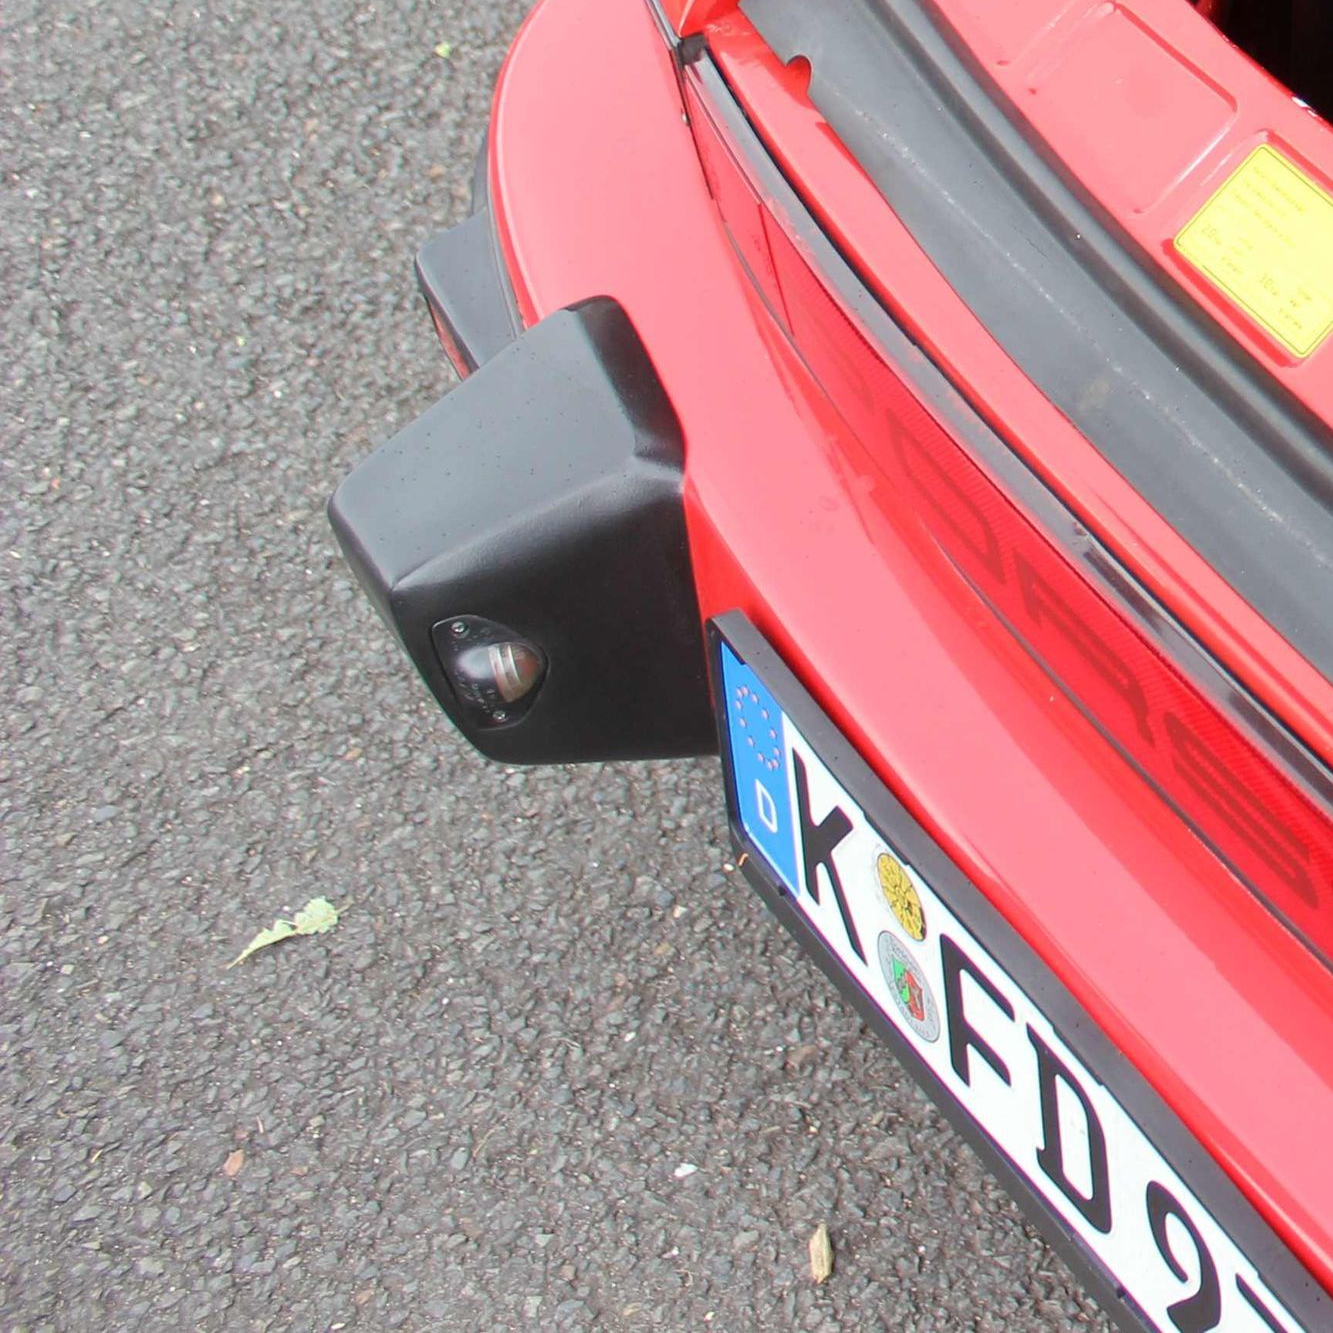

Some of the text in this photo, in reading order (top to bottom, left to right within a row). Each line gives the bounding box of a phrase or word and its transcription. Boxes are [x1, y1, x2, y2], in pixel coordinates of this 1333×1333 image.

[755, 779, 777, 833] D
[792, 747, 1289, 1333] K FD 9
